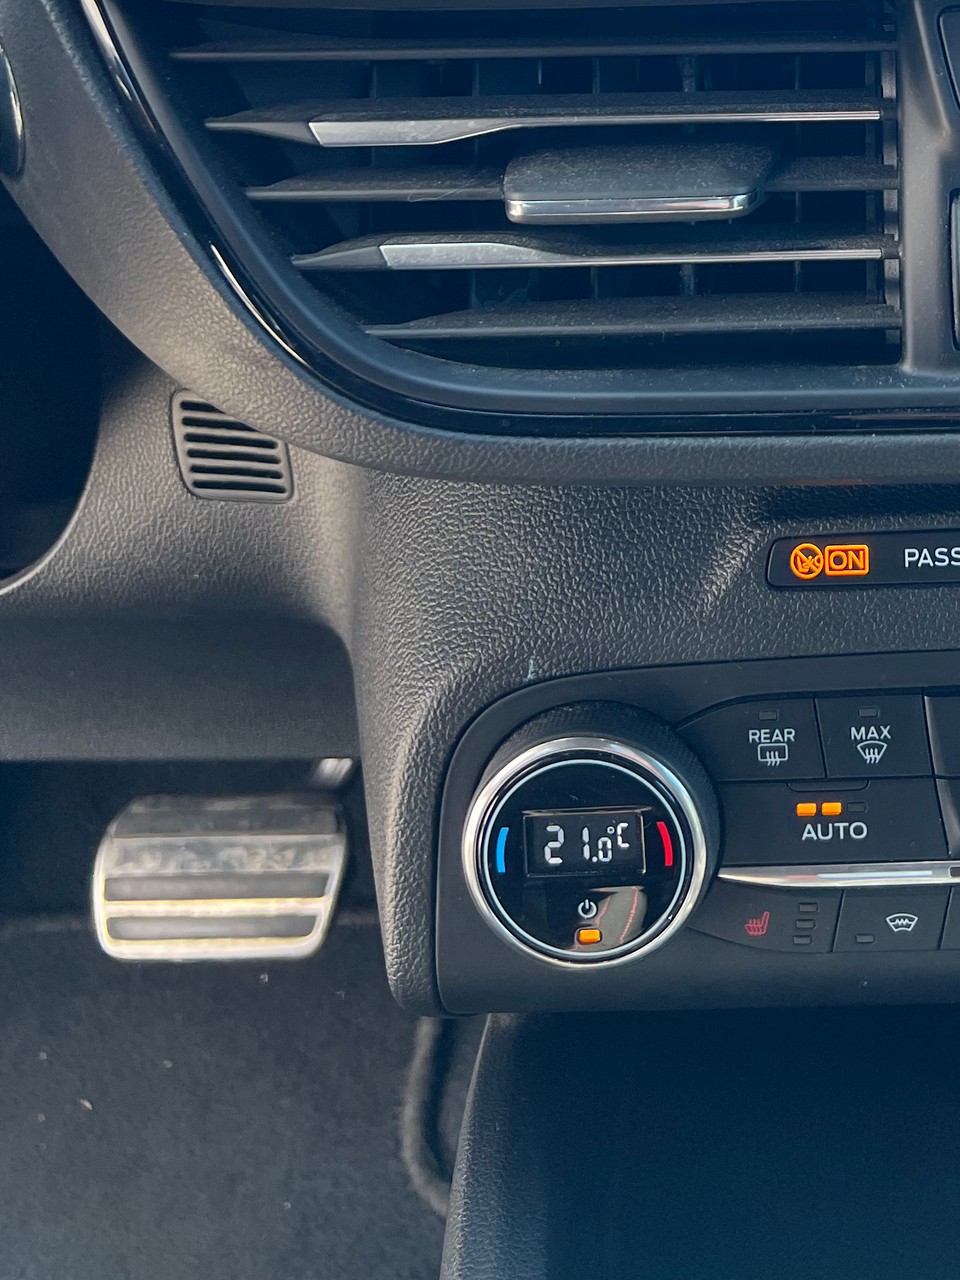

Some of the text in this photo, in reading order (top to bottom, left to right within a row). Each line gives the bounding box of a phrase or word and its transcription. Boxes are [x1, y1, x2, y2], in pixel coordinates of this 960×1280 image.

[829, 549, 865, 573] ON
[748, 729, 796, 744] REAR
[850, 725, 892, 741] MAX
[801, 821, 868, 841] AUTO
